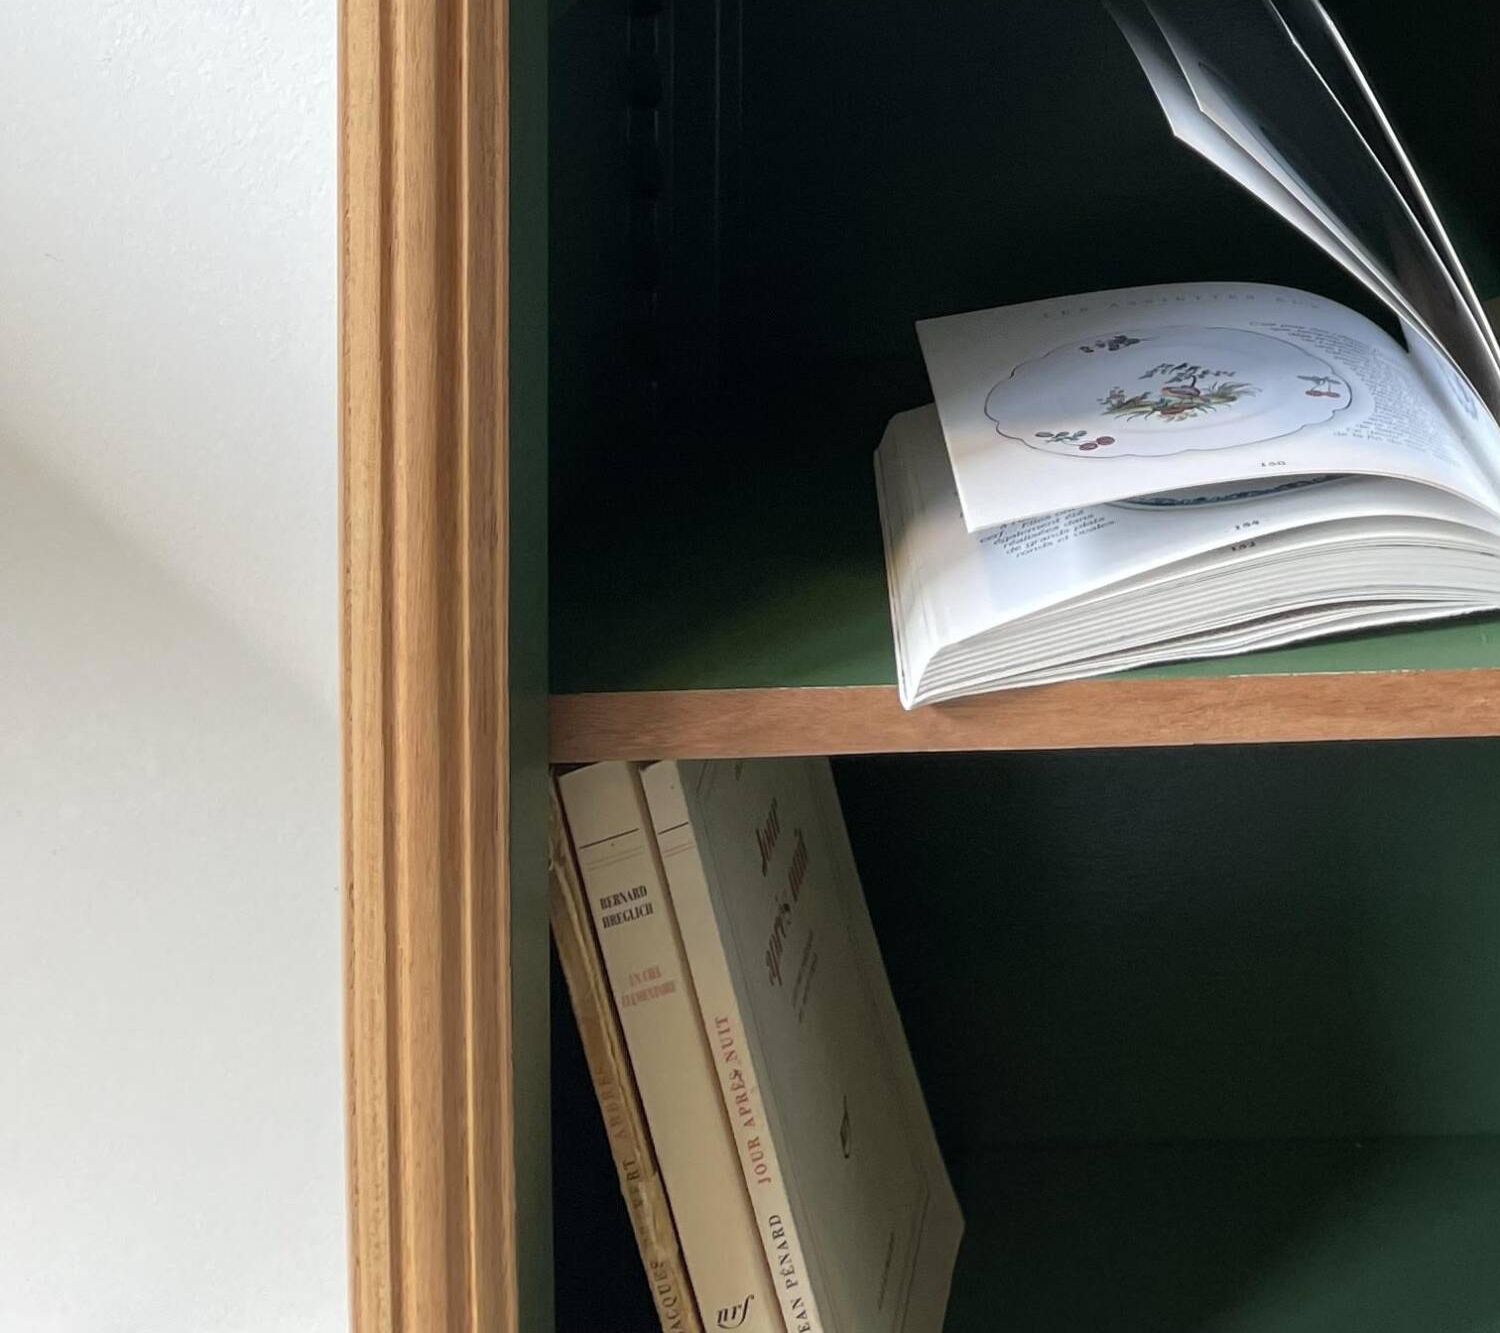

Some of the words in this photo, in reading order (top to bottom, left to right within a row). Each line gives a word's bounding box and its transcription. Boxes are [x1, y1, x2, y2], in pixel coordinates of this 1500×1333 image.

[600, 885, 648, 910] BERNARD
[715, 1016, 738, 1063] NUIT
[747, 1136, 772, 1184] JOUR
[650, 1261, 683, 1333] ACQUES
[791, 1297, 811, 1333] EAN
